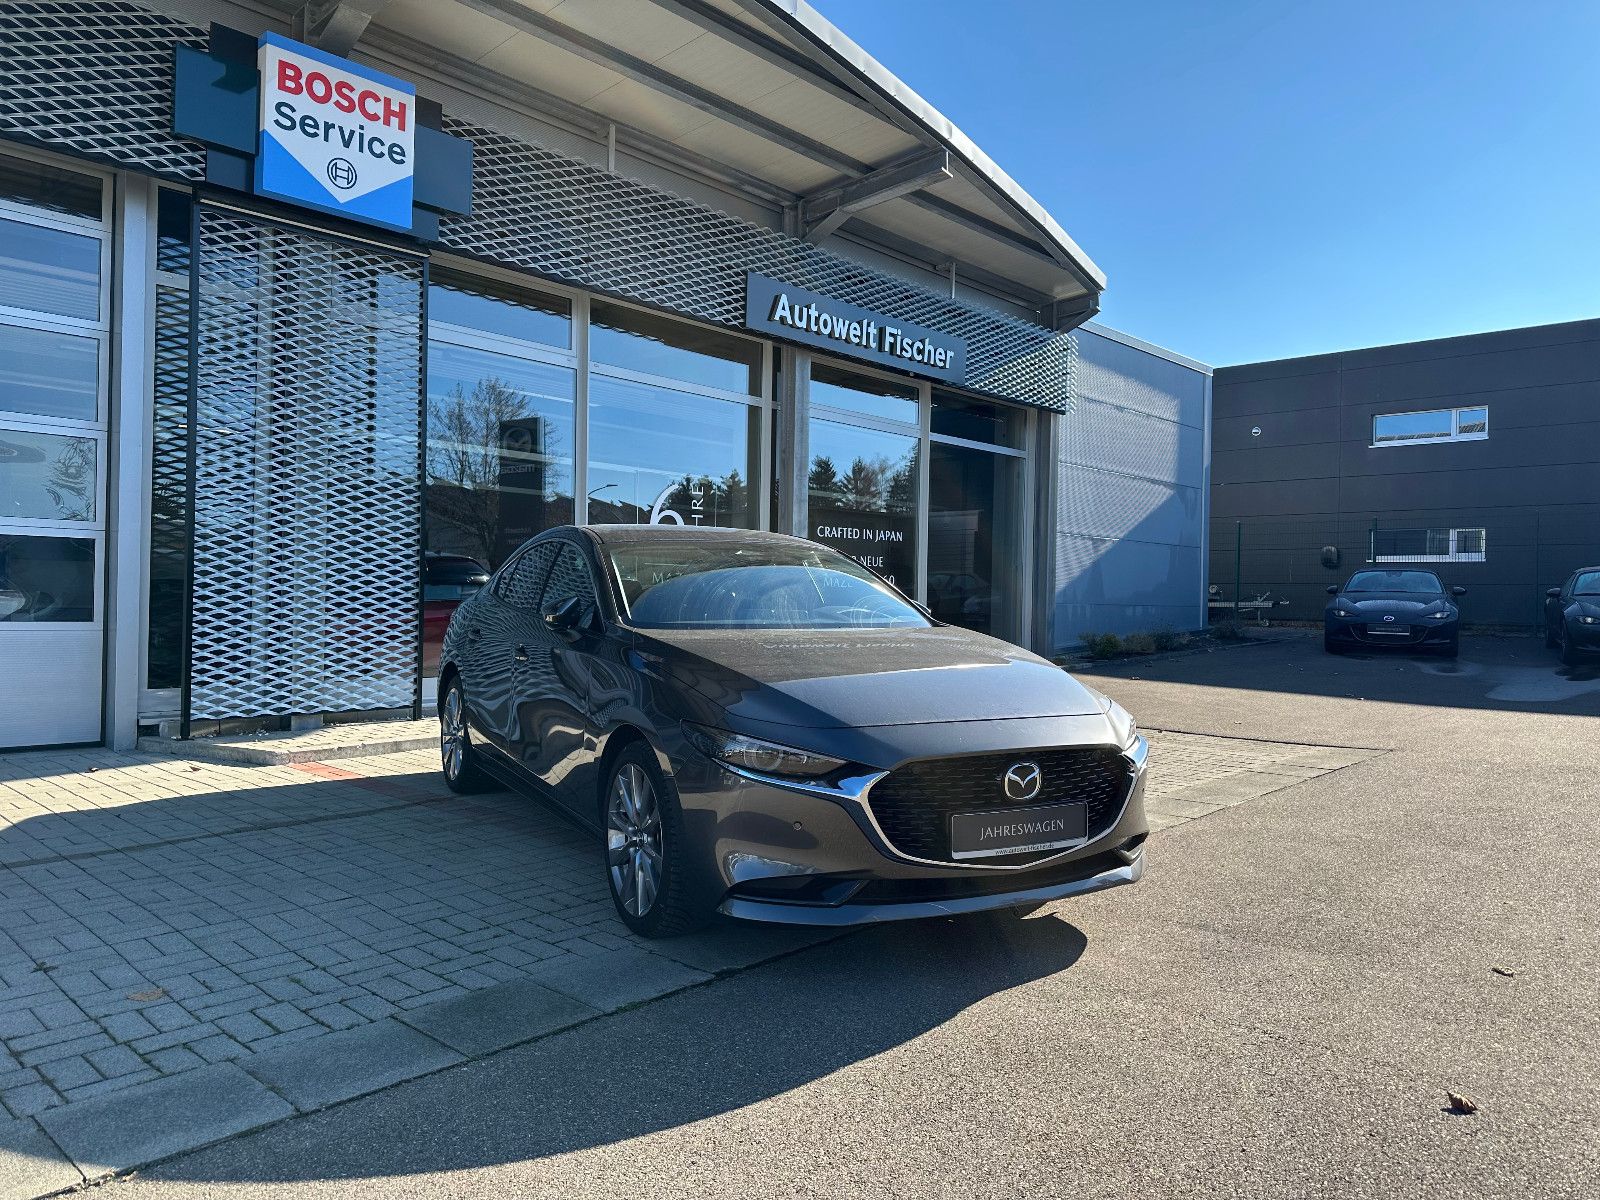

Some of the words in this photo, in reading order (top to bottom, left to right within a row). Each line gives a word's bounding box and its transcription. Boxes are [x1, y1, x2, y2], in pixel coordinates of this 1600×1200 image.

[277, 59, 406, 132] BOSCH
[273, 101, 406, 165] Service
[772, 293, 877, 349] Autowelt
[884, 325, 954, 369] Fischer
[817, 526, 860, 539] CRAFTED
[863, 528, 873, 540] IN
[874, 530, 903, 542] JAPAN
[980, 819, 1064, 841] JAHRESWAGEN
